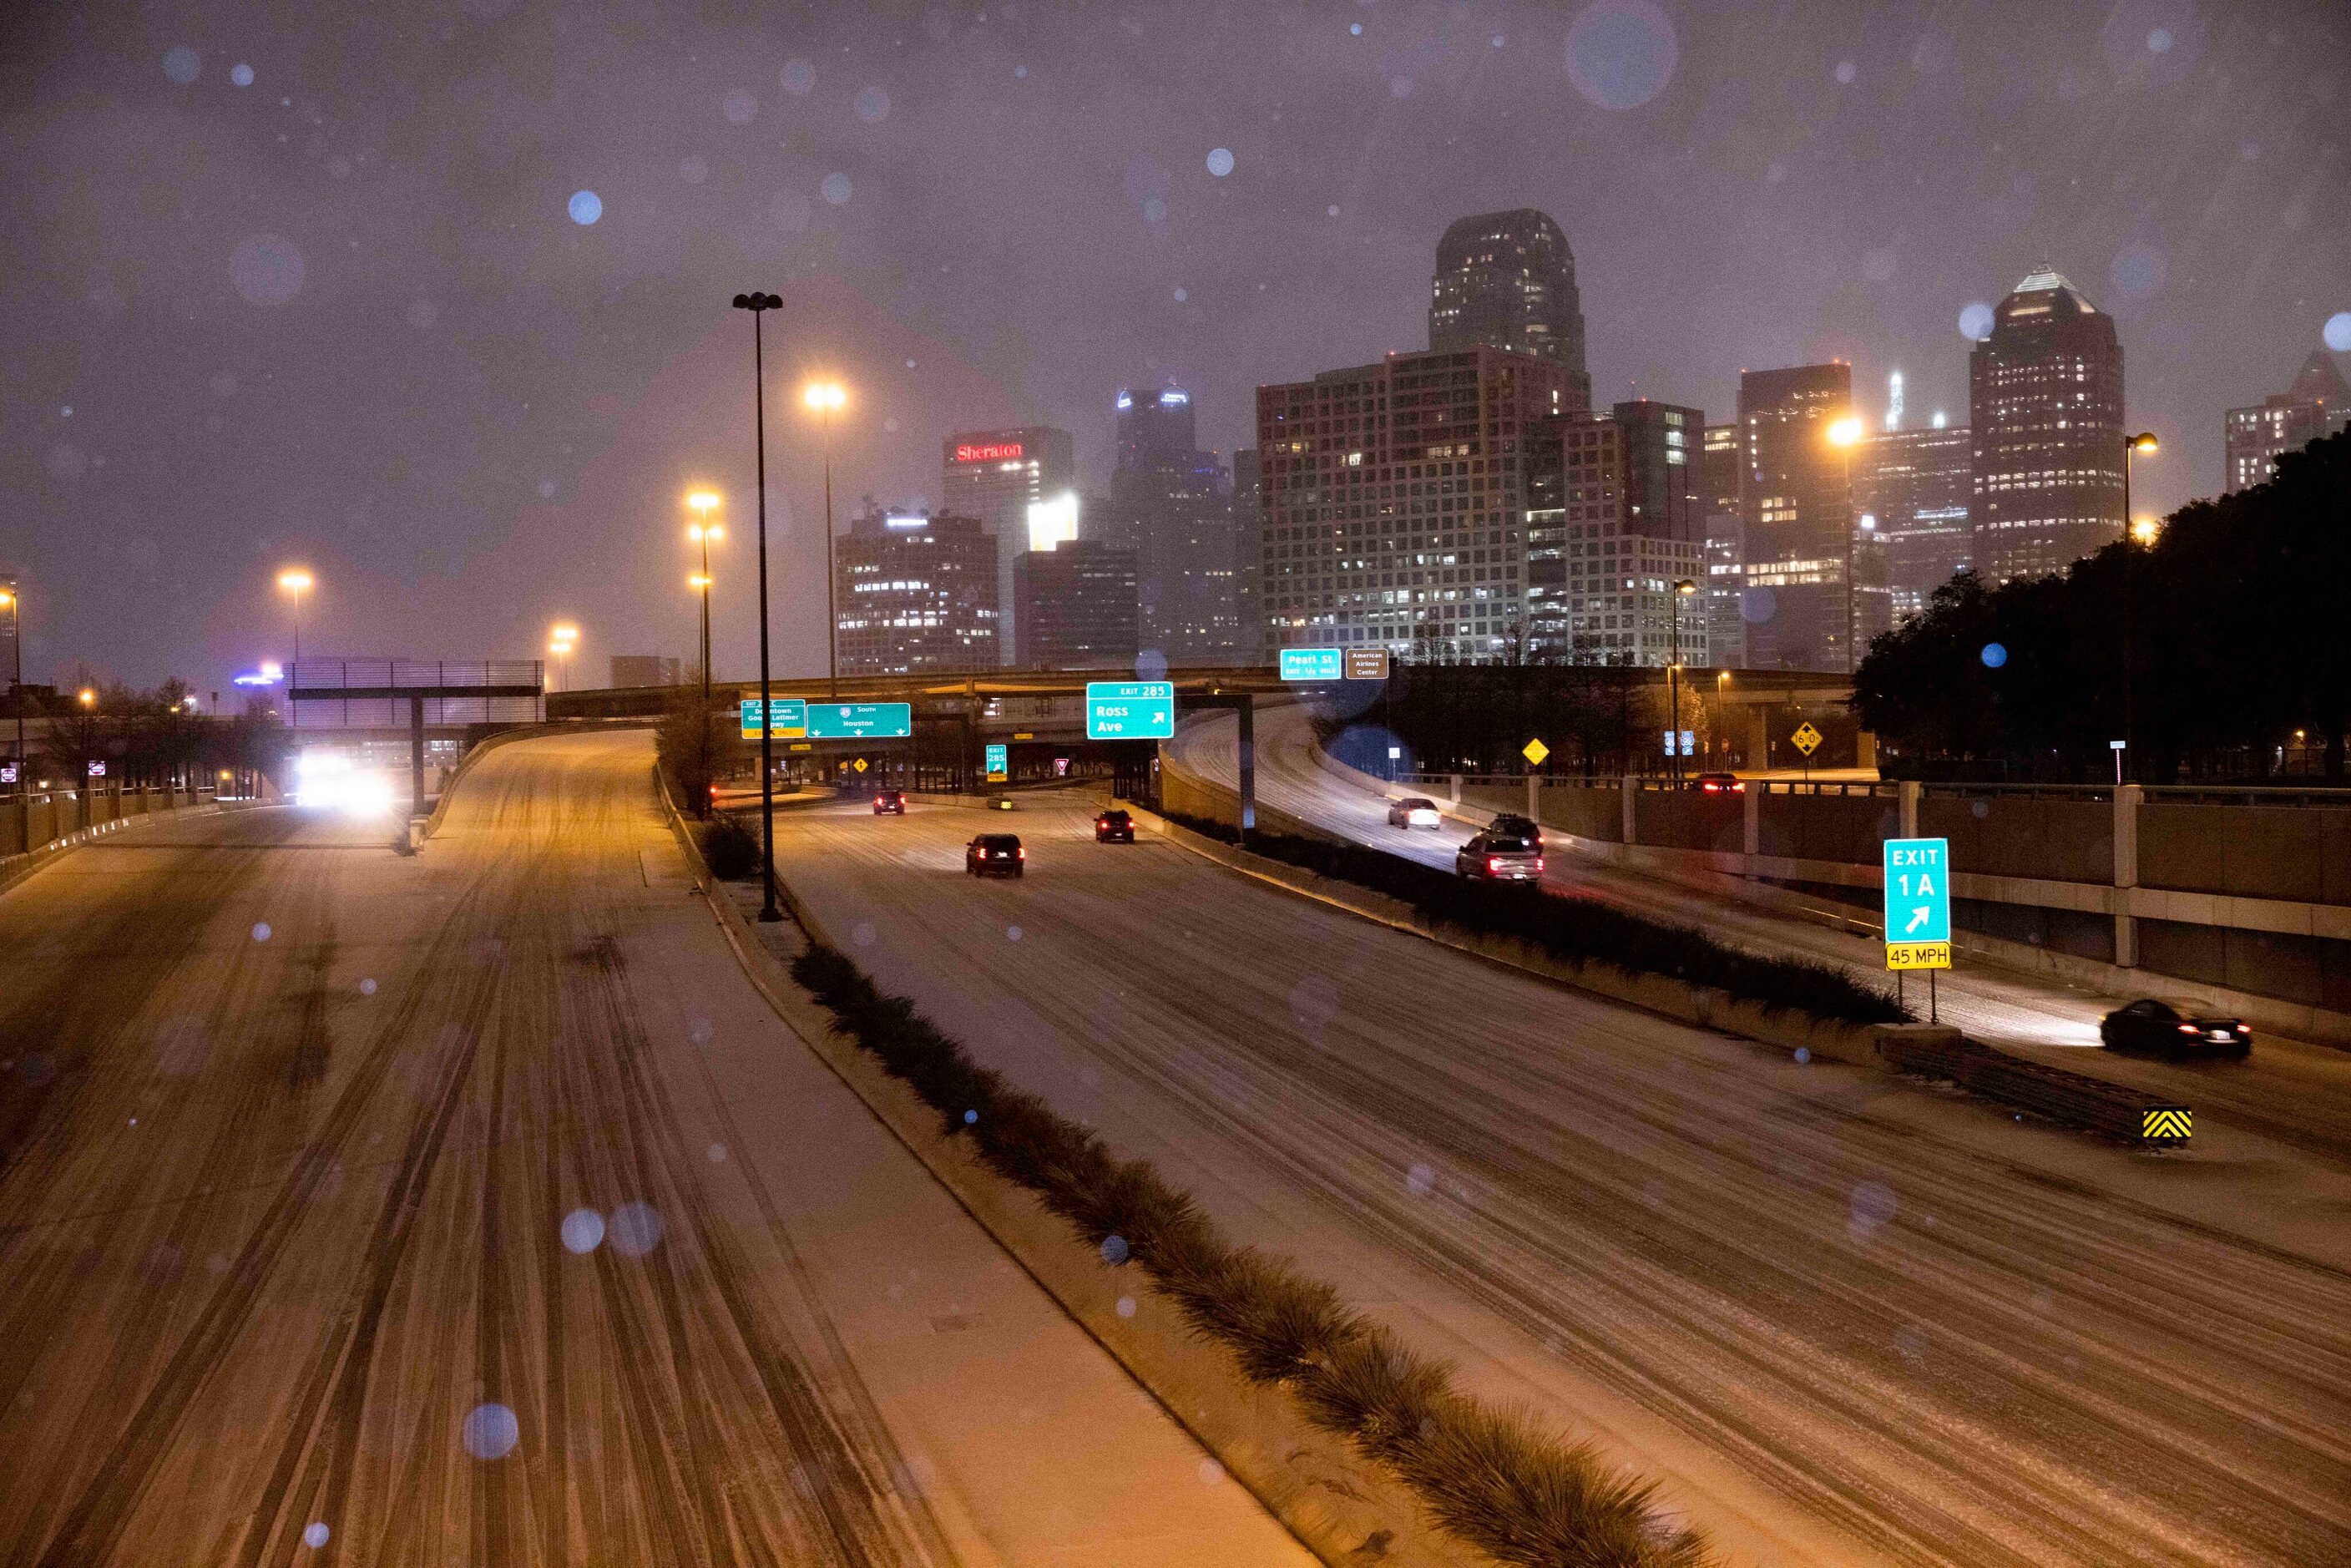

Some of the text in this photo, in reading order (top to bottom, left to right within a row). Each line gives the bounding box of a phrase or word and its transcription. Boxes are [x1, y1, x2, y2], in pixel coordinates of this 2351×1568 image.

[958, 444, 1023, 460] Sheraton
[1288, 655, 1332, 665] Pearl St
[1142, 685, 1165, 696] 285
[1096, 706, 1129, 716] Ross
[1097, 721, 1123, 731] Ave
[1893, 849, 1938, 866] EXIT
[1890, 948, 1947, 964] 45 MPH
